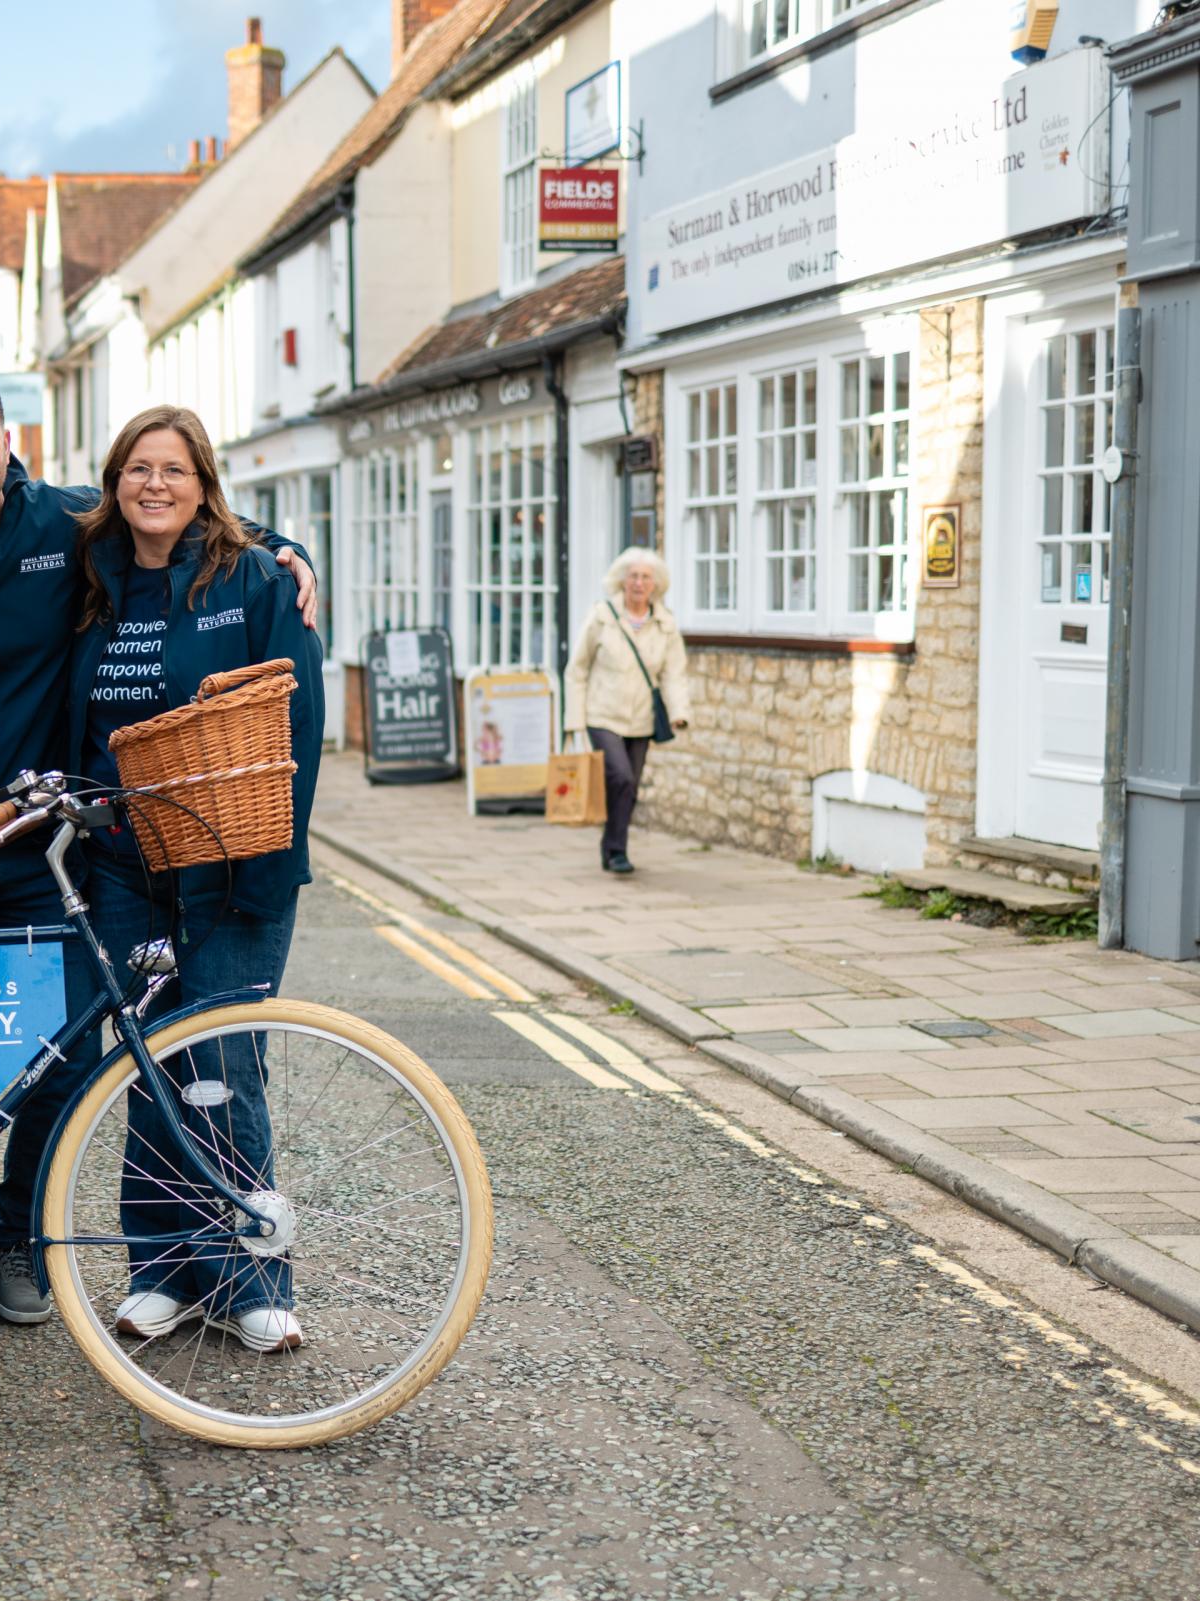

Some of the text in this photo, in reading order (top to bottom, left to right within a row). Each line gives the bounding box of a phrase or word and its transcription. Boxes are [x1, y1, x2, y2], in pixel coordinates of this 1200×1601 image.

[668, 210, 723, 249] Surman
[728, 197, 741, 226] &
[745, 165, 823, 221] Horwood
[992, 85, 1028, 131] Ltd
[544, 180, 615, 200] FIELDS
[544, 199, 614, 210] COMMERCIAL
[690, 251, 711, 276] only
[714, 232, 774, 268] independent
[778, 216, 813, 245] family
[817, 214, 837, 236] run
[20, 560, 65, 571] SATURDAY
[197, 614, 243, 629] SATURDAY
[377, 690, 440, 720] Hair
